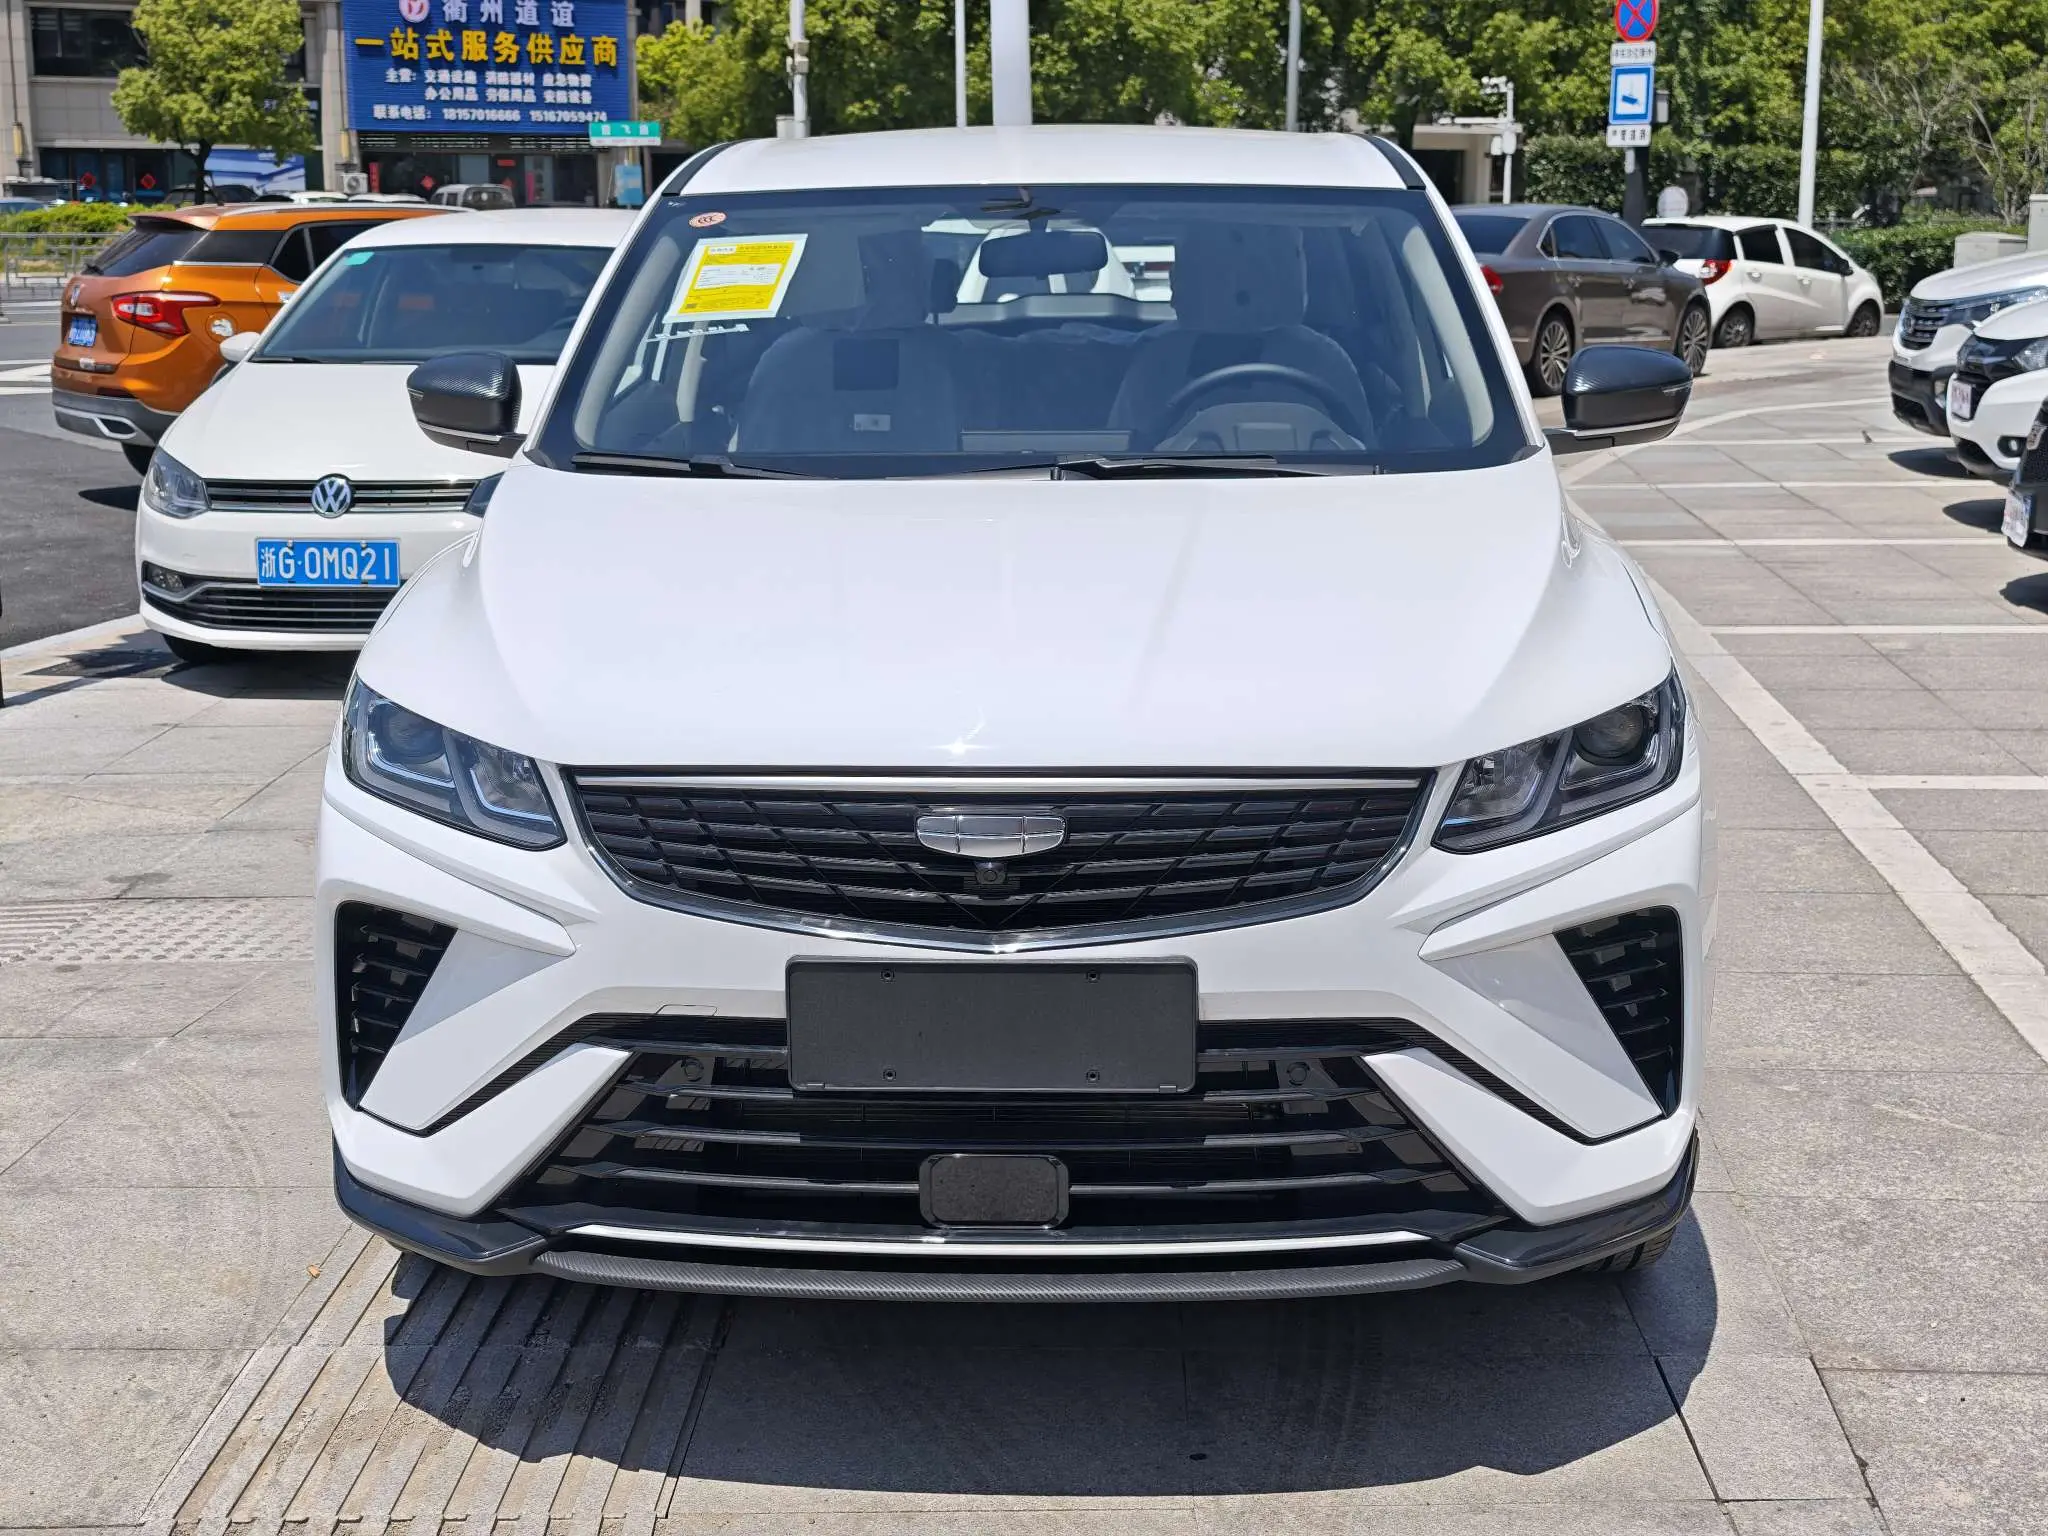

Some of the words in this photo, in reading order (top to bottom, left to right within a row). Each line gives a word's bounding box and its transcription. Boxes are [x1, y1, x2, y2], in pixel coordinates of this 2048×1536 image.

[355, 27, 618, 67] 一站式服务供应商
[424, 86, 479, 101] 办公用品
